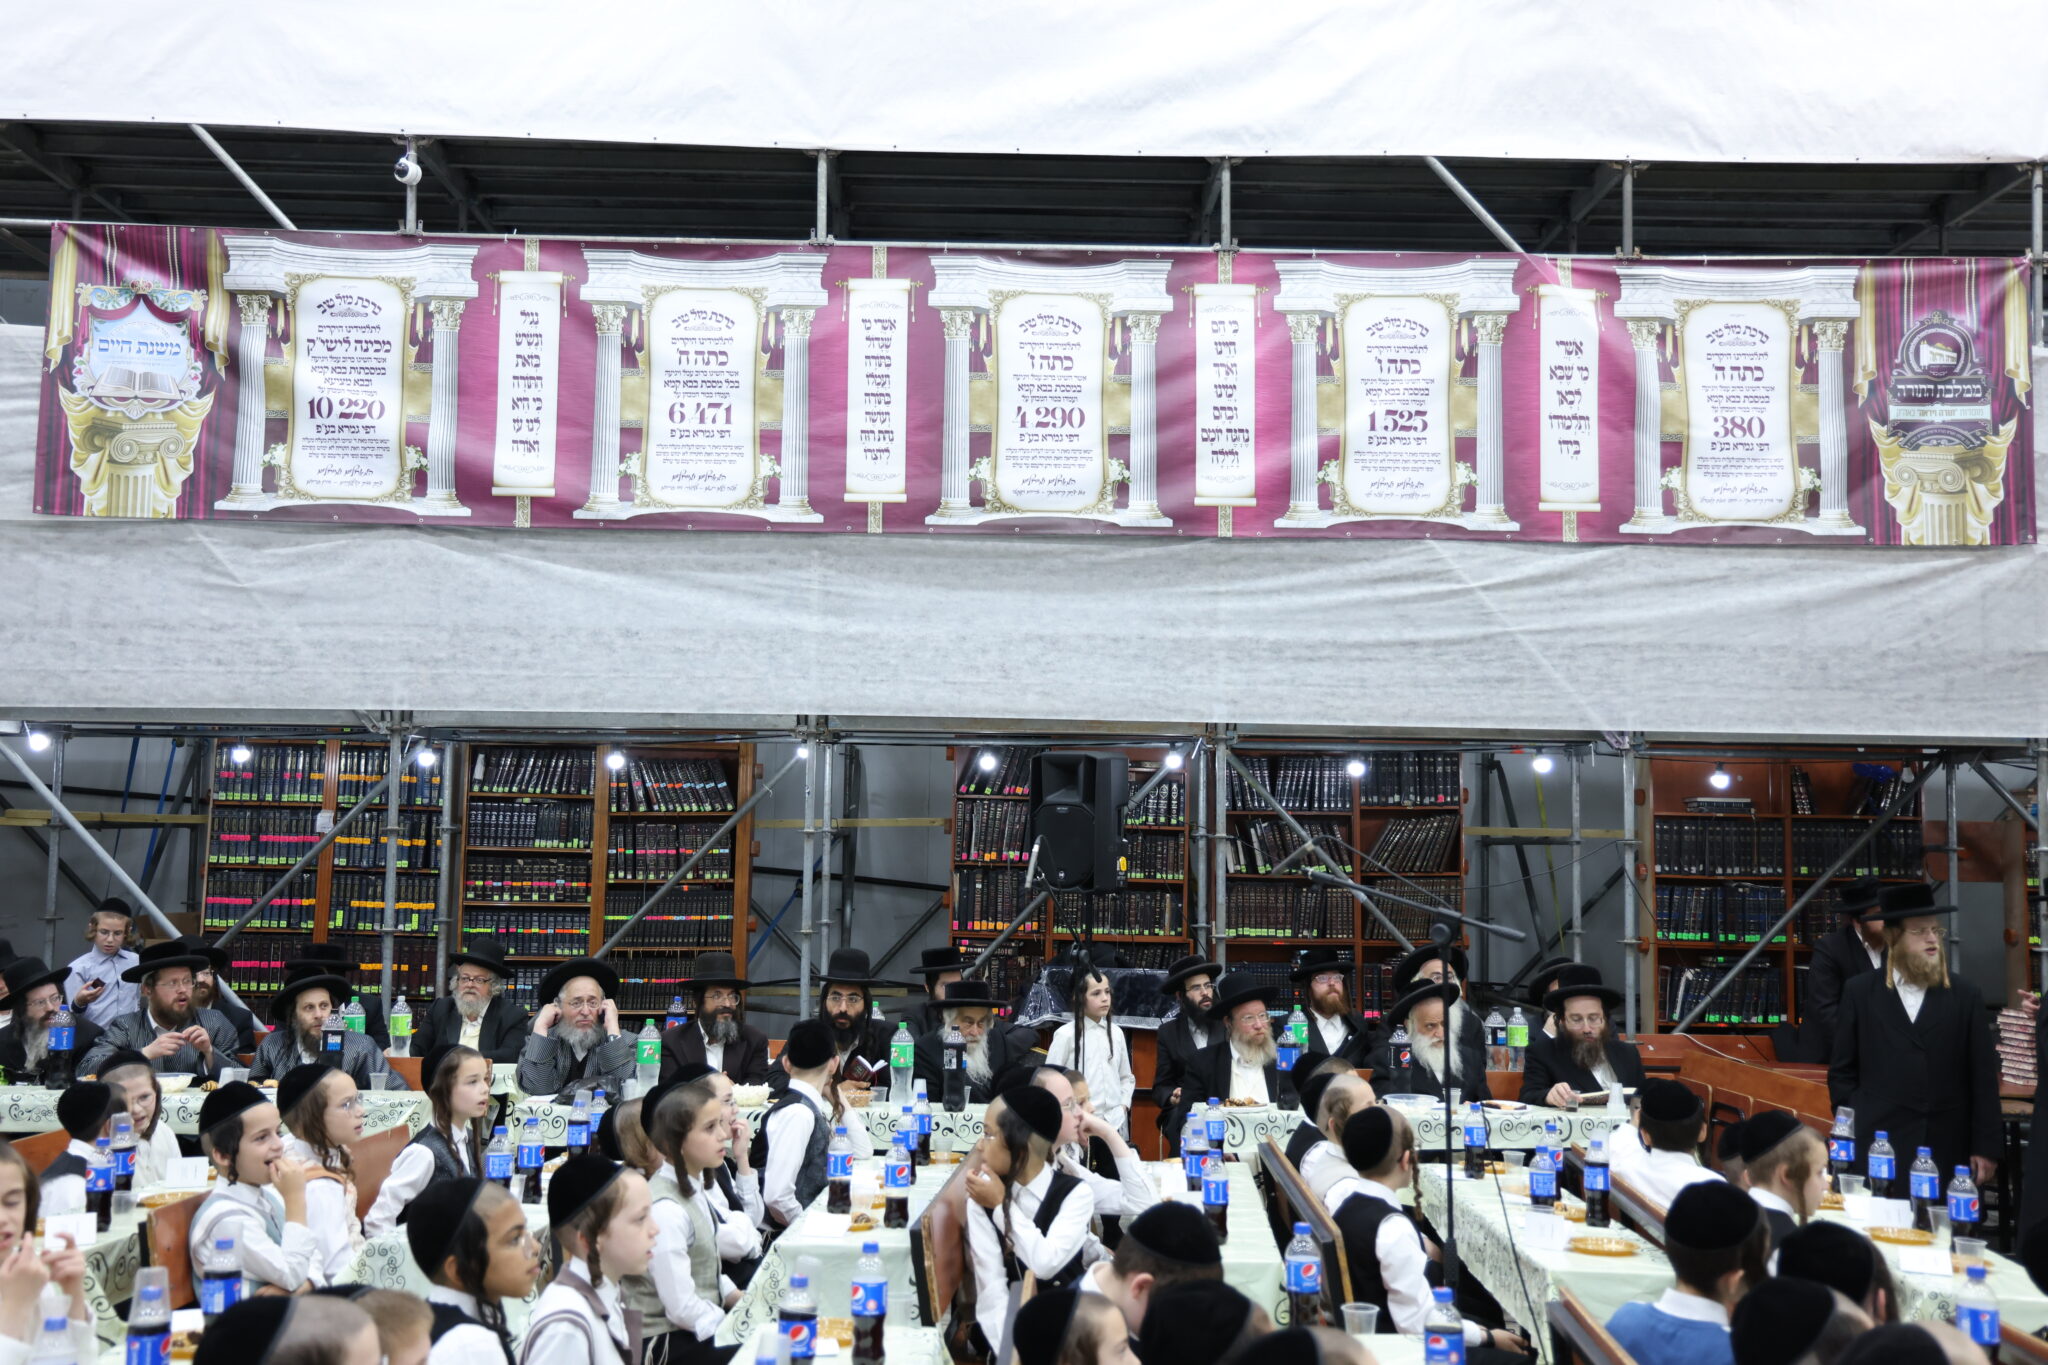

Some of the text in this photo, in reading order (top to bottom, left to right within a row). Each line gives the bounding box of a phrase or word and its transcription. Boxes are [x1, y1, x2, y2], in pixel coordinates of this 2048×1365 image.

[335, 294, 353, 305] מזל
[355, 296, 382, 315] ברכת
[690, 309, 707, 320] מזל
[709, 311, 735, 329] ברכת
[1037, 313, 1054, 325] מזל
[1056, 316, 1082, 335] ברכת
[1384, 317, 1401, 328] מזל
[1403, 319, 1429, 337] ברכת
[1724, 324, 1741, 335] מזל
[1743, 326, 1769, 344] ברכת
[136, 341, 181, 356] משנת
[355, 340, 392, 353] מכינה
[695, 351, 728, 366] כתה
[1040, 355, 1073, 371] כתה
[1388, 359, 1421, 374] כתה
[1730, 366, 1764, 381] כתה
[1896, 379, 1982, 398] ממלכת התורה
[1714, 416, 1765, 438] 380
